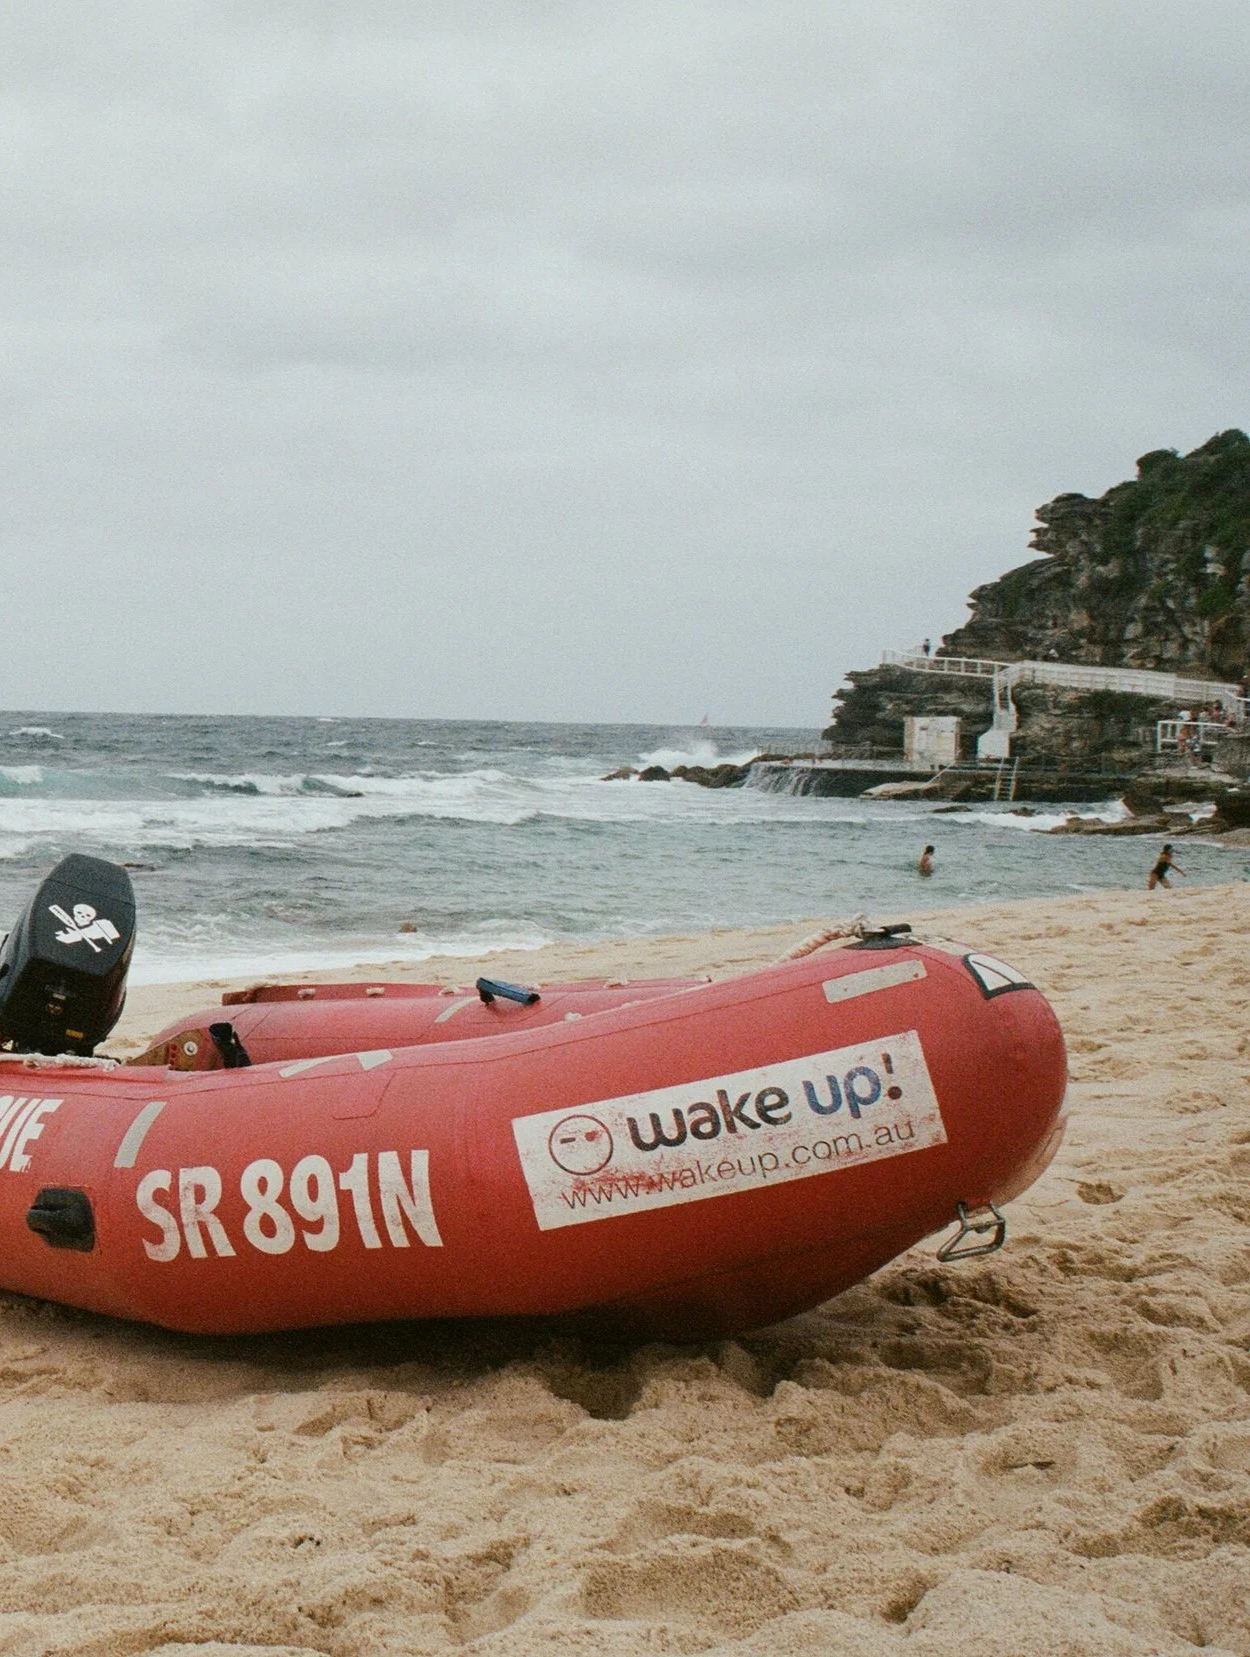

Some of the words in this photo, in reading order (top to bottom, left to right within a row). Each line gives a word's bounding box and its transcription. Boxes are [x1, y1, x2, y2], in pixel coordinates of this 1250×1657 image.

[626, 1085, 793, 1152] wake
[801, 1052, 903, 1119] up!
[136, 1165, 237, 1262] SR
[240, 1149, 444, 1255] 891N
[560, 1118, 915, 1211] www.wakeup.com.au
